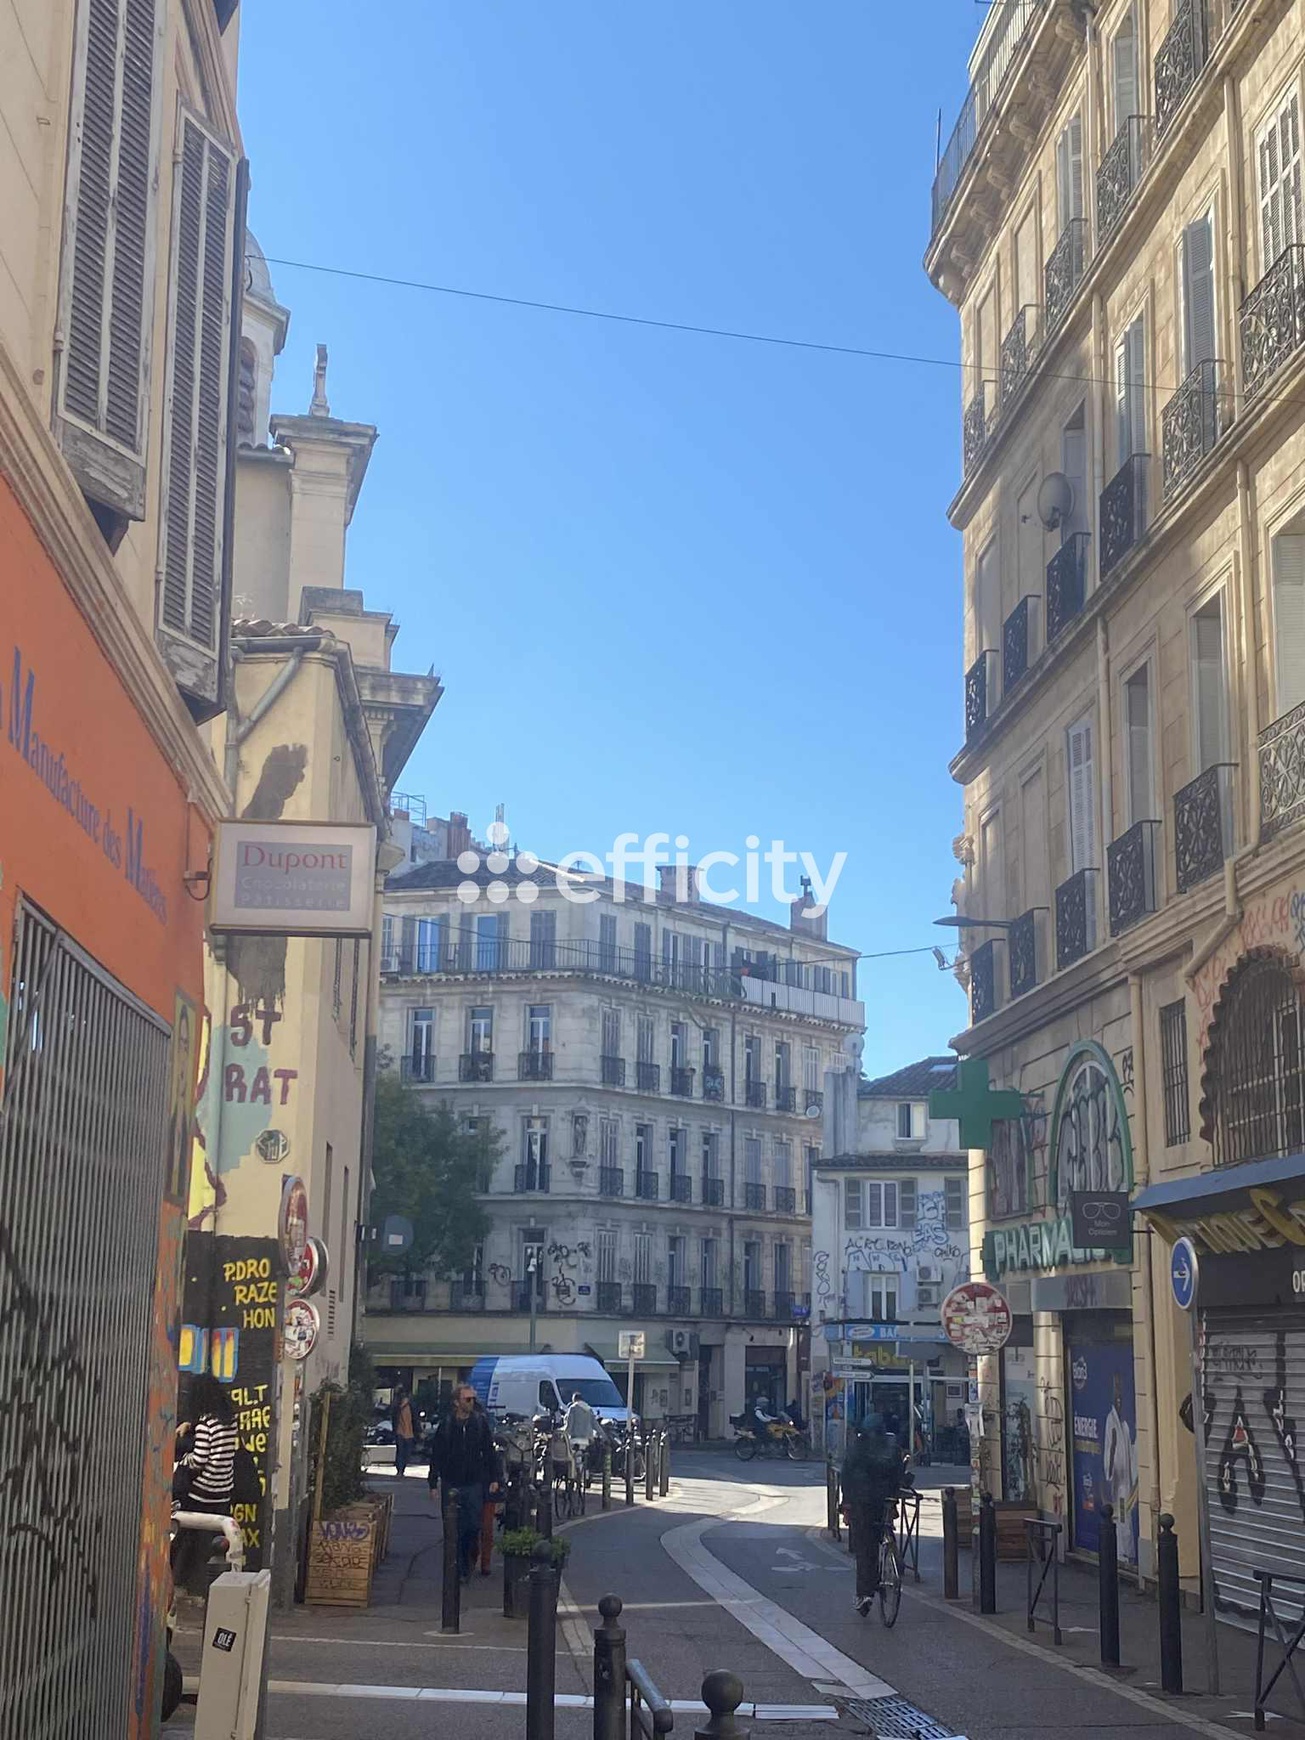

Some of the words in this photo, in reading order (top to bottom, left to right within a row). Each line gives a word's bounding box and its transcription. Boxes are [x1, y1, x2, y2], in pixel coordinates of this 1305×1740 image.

[243, 844, 348, 875] Dupont
[225, 1063, 298, 1105] RAT
[994, 1219, 1106, 1273] PHARMA
[234, 1282, 277, 1306] RAZE
[243, 1307, 275, 1329] HON
